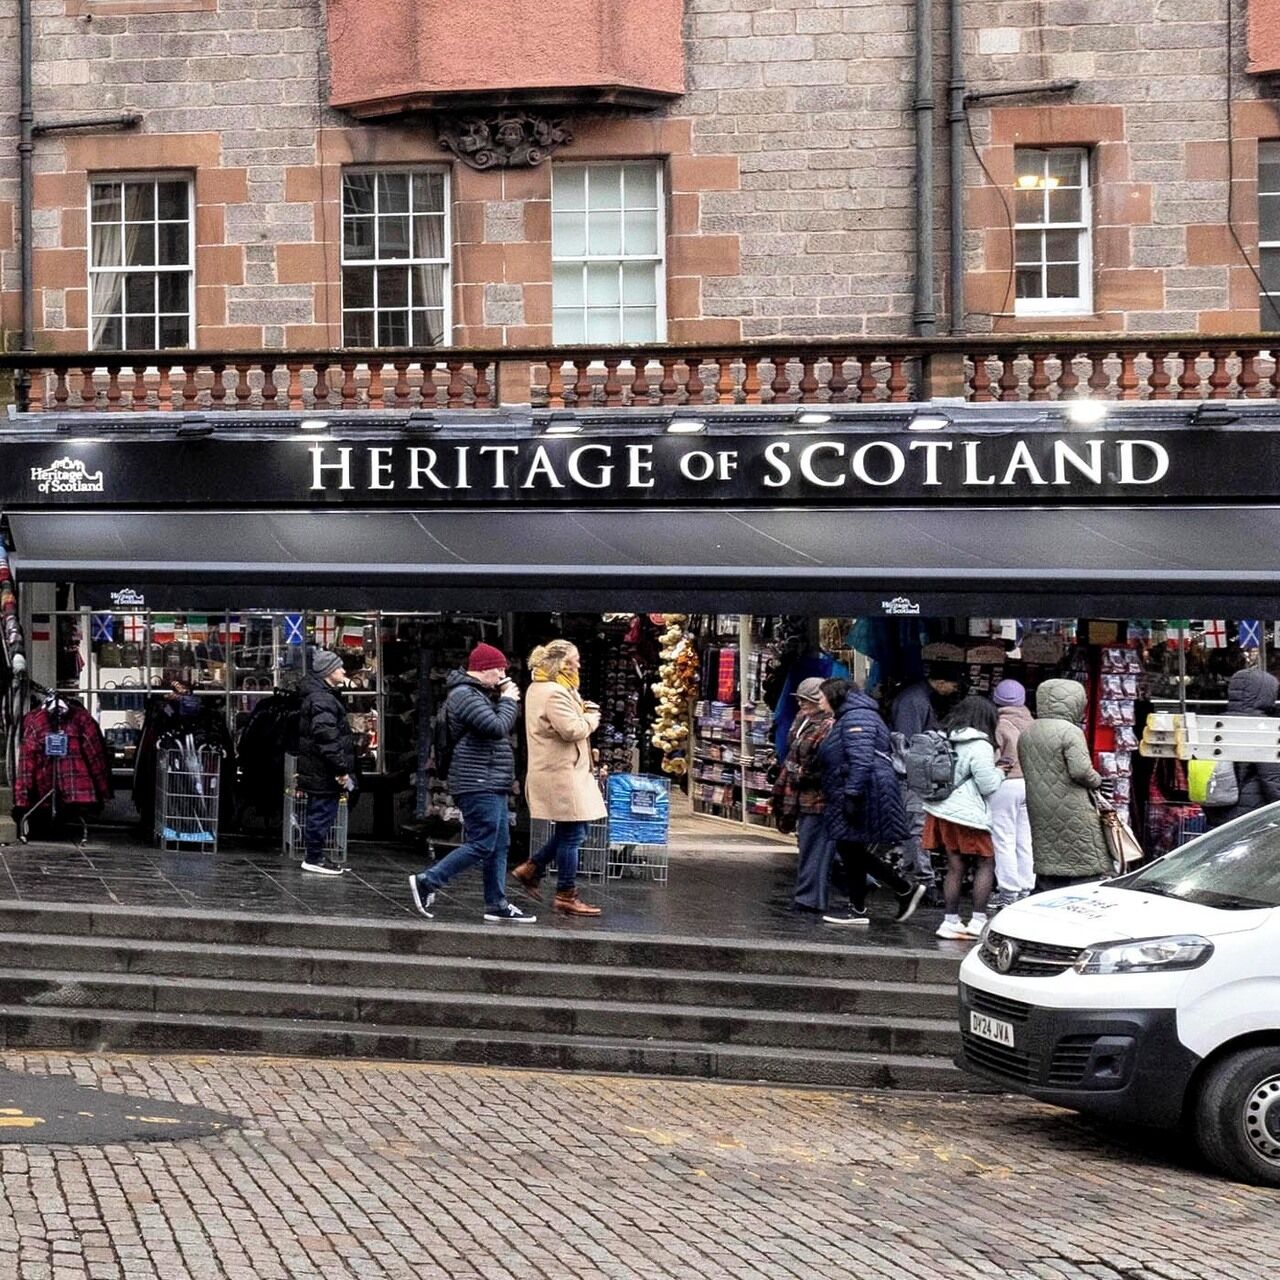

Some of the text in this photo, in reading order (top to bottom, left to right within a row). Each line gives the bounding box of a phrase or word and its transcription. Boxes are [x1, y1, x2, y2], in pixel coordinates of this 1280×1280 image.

[309, 440, 1170, 490] HERITAGE OF SCOTLAND
[30, 468, 83, 482] Heritage
[38, 481, 104, 493] of Scotland
